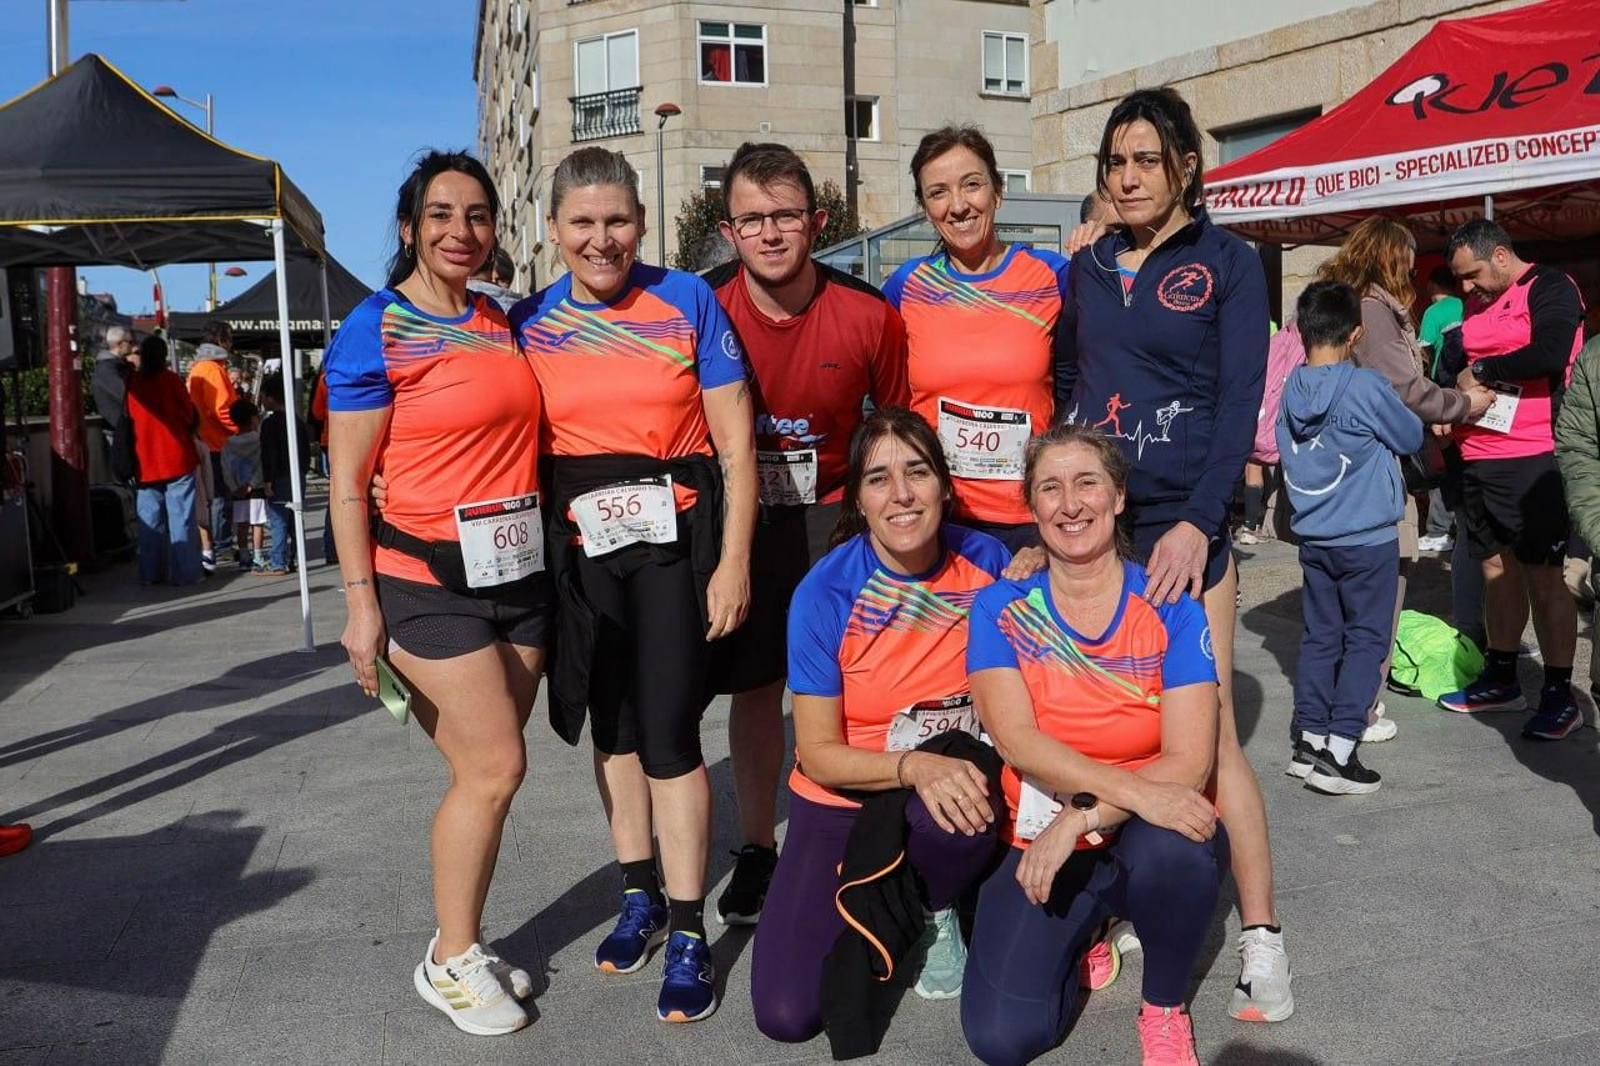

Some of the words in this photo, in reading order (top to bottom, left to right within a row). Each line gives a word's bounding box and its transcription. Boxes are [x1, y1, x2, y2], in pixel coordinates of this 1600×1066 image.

[1315, 173, 1345, 197] QUE
[1349, 166, 1380, 189] BICI
[1395, 142, 1509, 181] SPECIALIZED
[955, 427, 1000, 452] 540
[596, 493, 642, 521] 556
[494, 521, 529, 549] 608
[918, 715, 962, 737] 594
